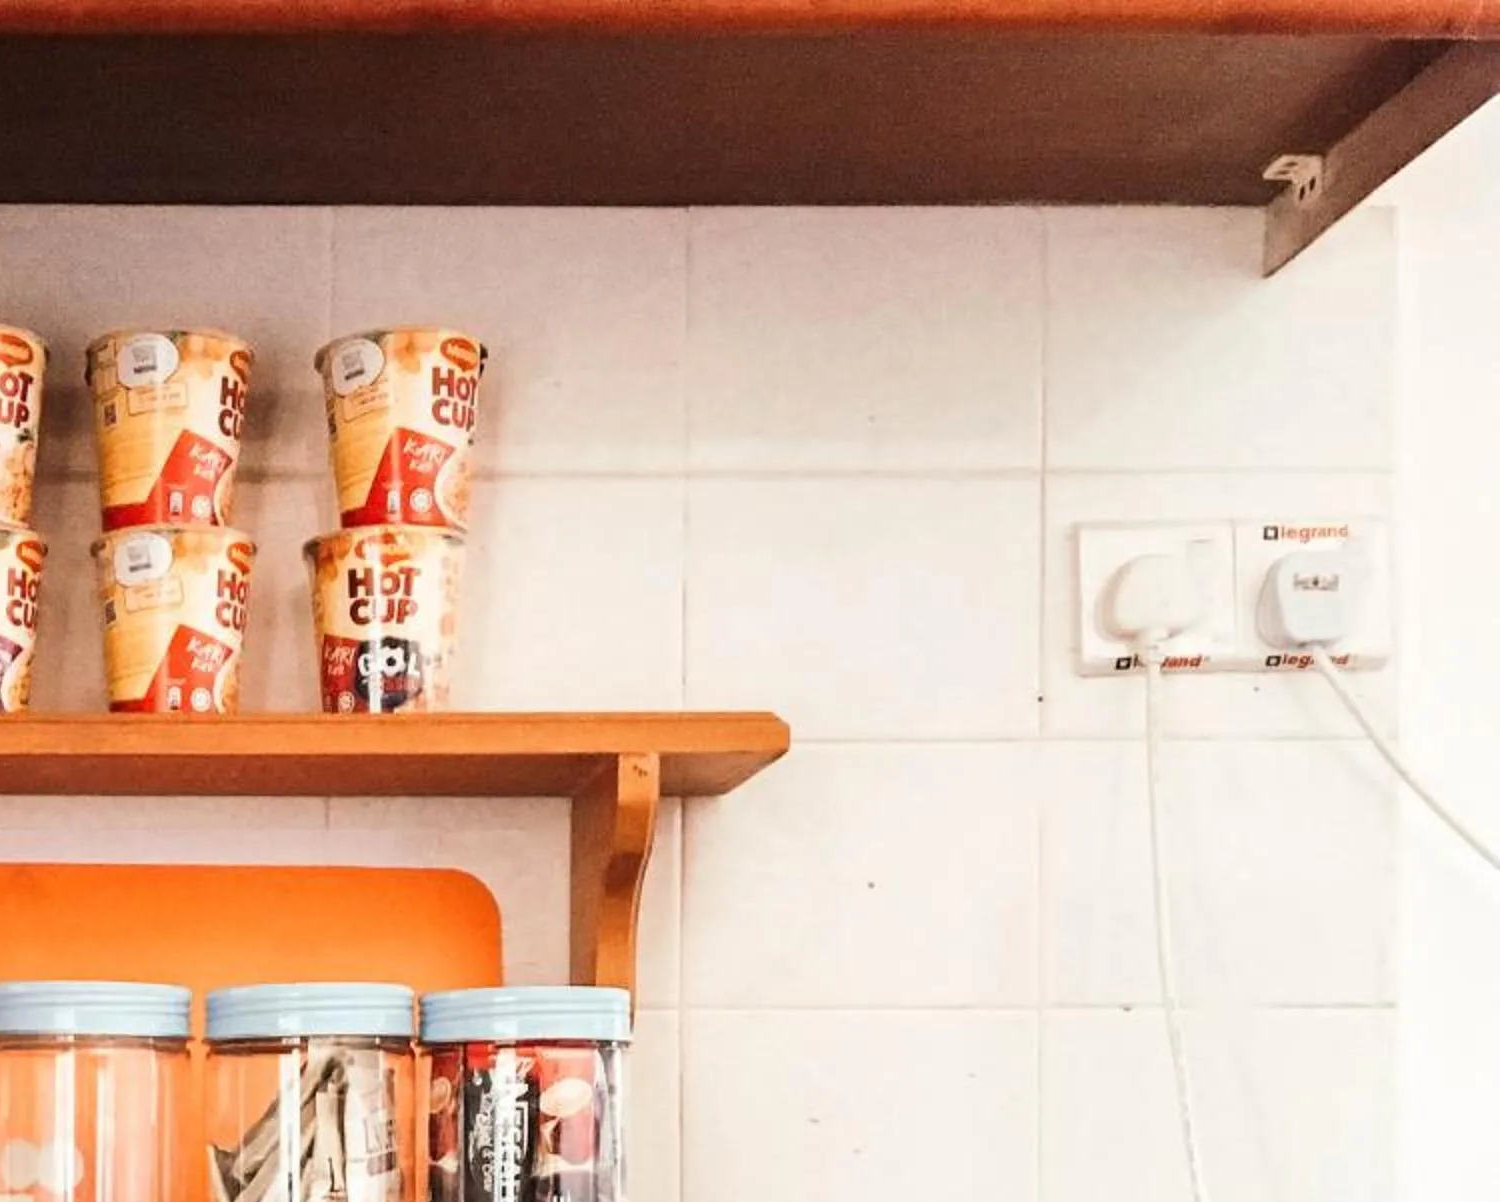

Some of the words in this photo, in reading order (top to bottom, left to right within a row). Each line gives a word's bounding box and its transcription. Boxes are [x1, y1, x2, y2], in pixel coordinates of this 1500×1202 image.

[220, 376, 245, 414] HO
[218, 409, 241, 440] CU
[1280, 525, 1349, 543] legrand
[7, 567, 40, 602] HO
[217, 569, 247, 605] HO
[347, 567, 420, 598] HOT
[6, 599, 38, 629] CU
[216, 601, 247, 631] CU
